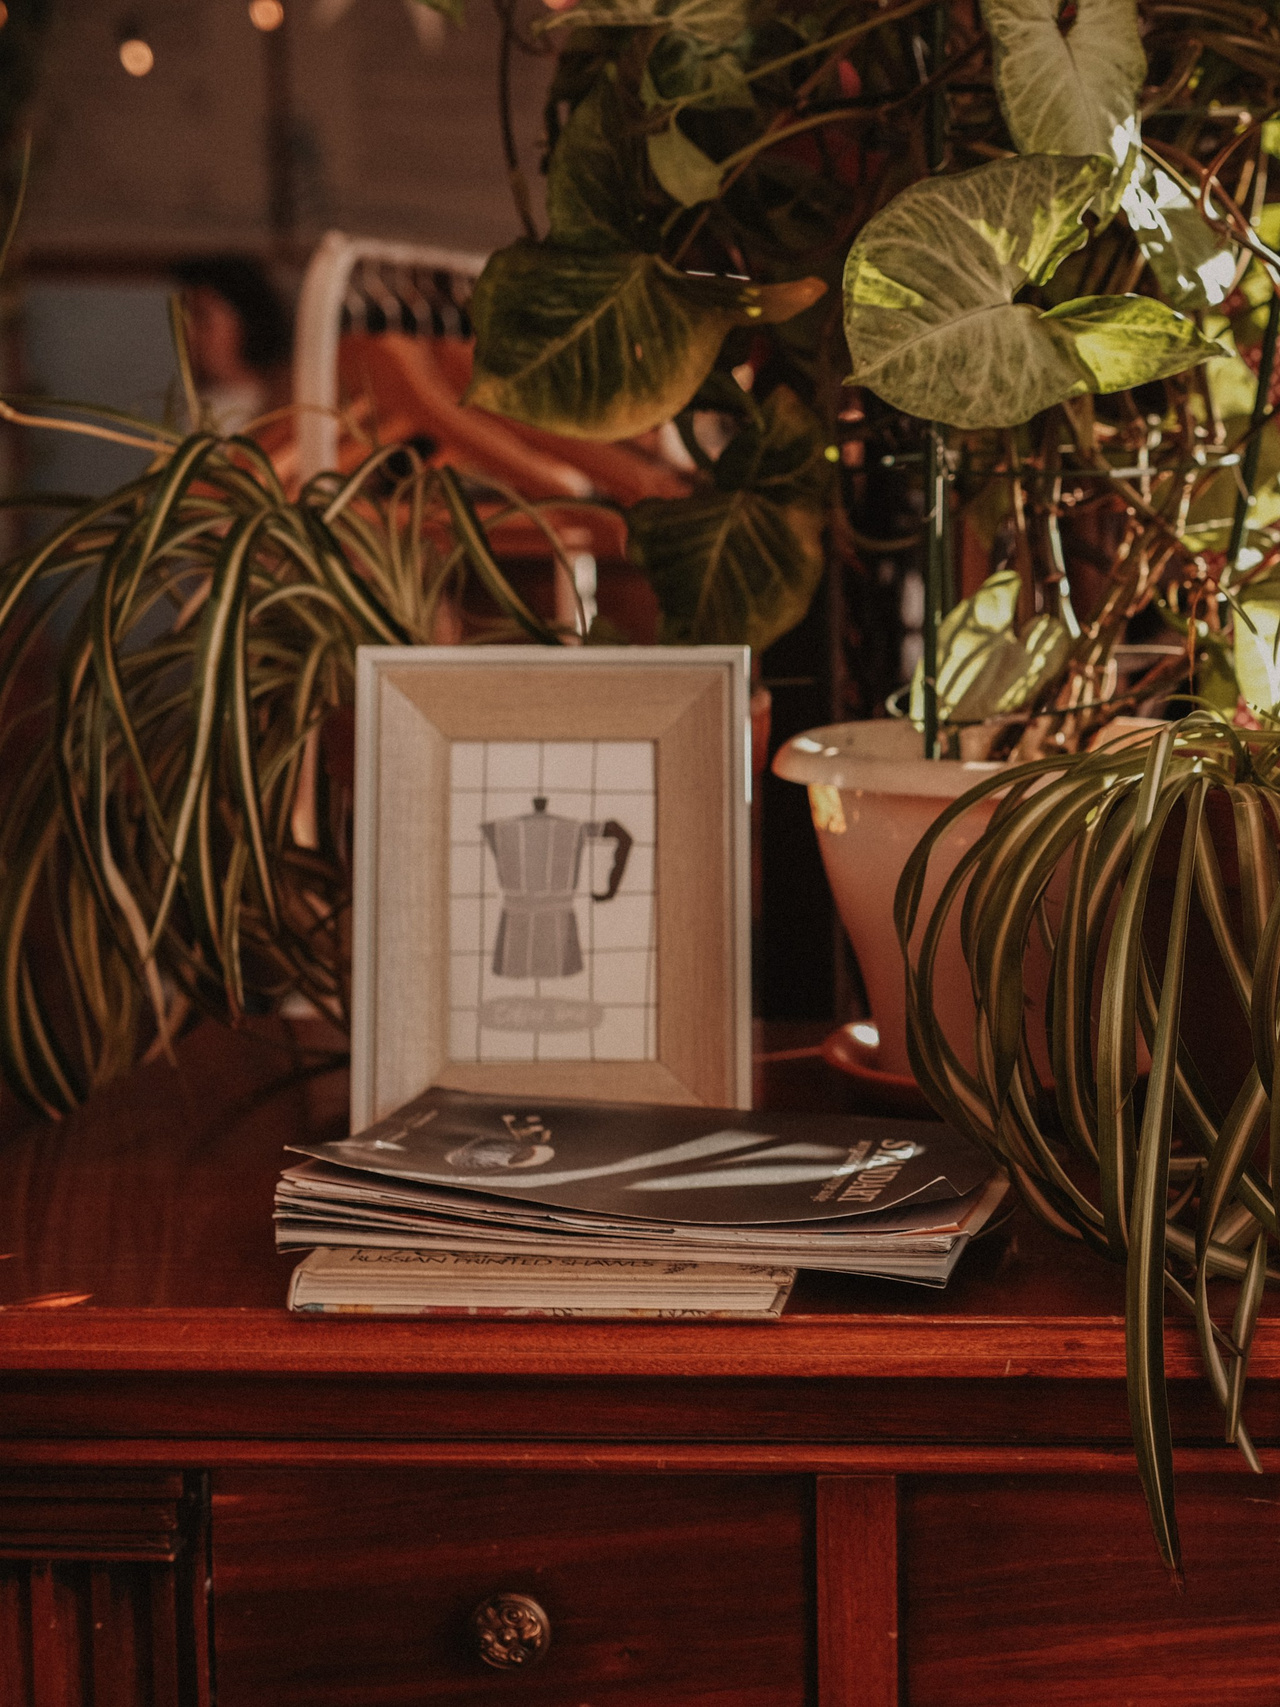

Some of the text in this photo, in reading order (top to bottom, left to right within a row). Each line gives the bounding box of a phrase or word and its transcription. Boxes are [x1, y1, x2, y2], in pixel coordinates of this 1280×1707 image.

[837, 1139, 917, 1203] STANDART
[350, 1254, 654, 1267] RUSSIAN PRINTED SHAWLS
